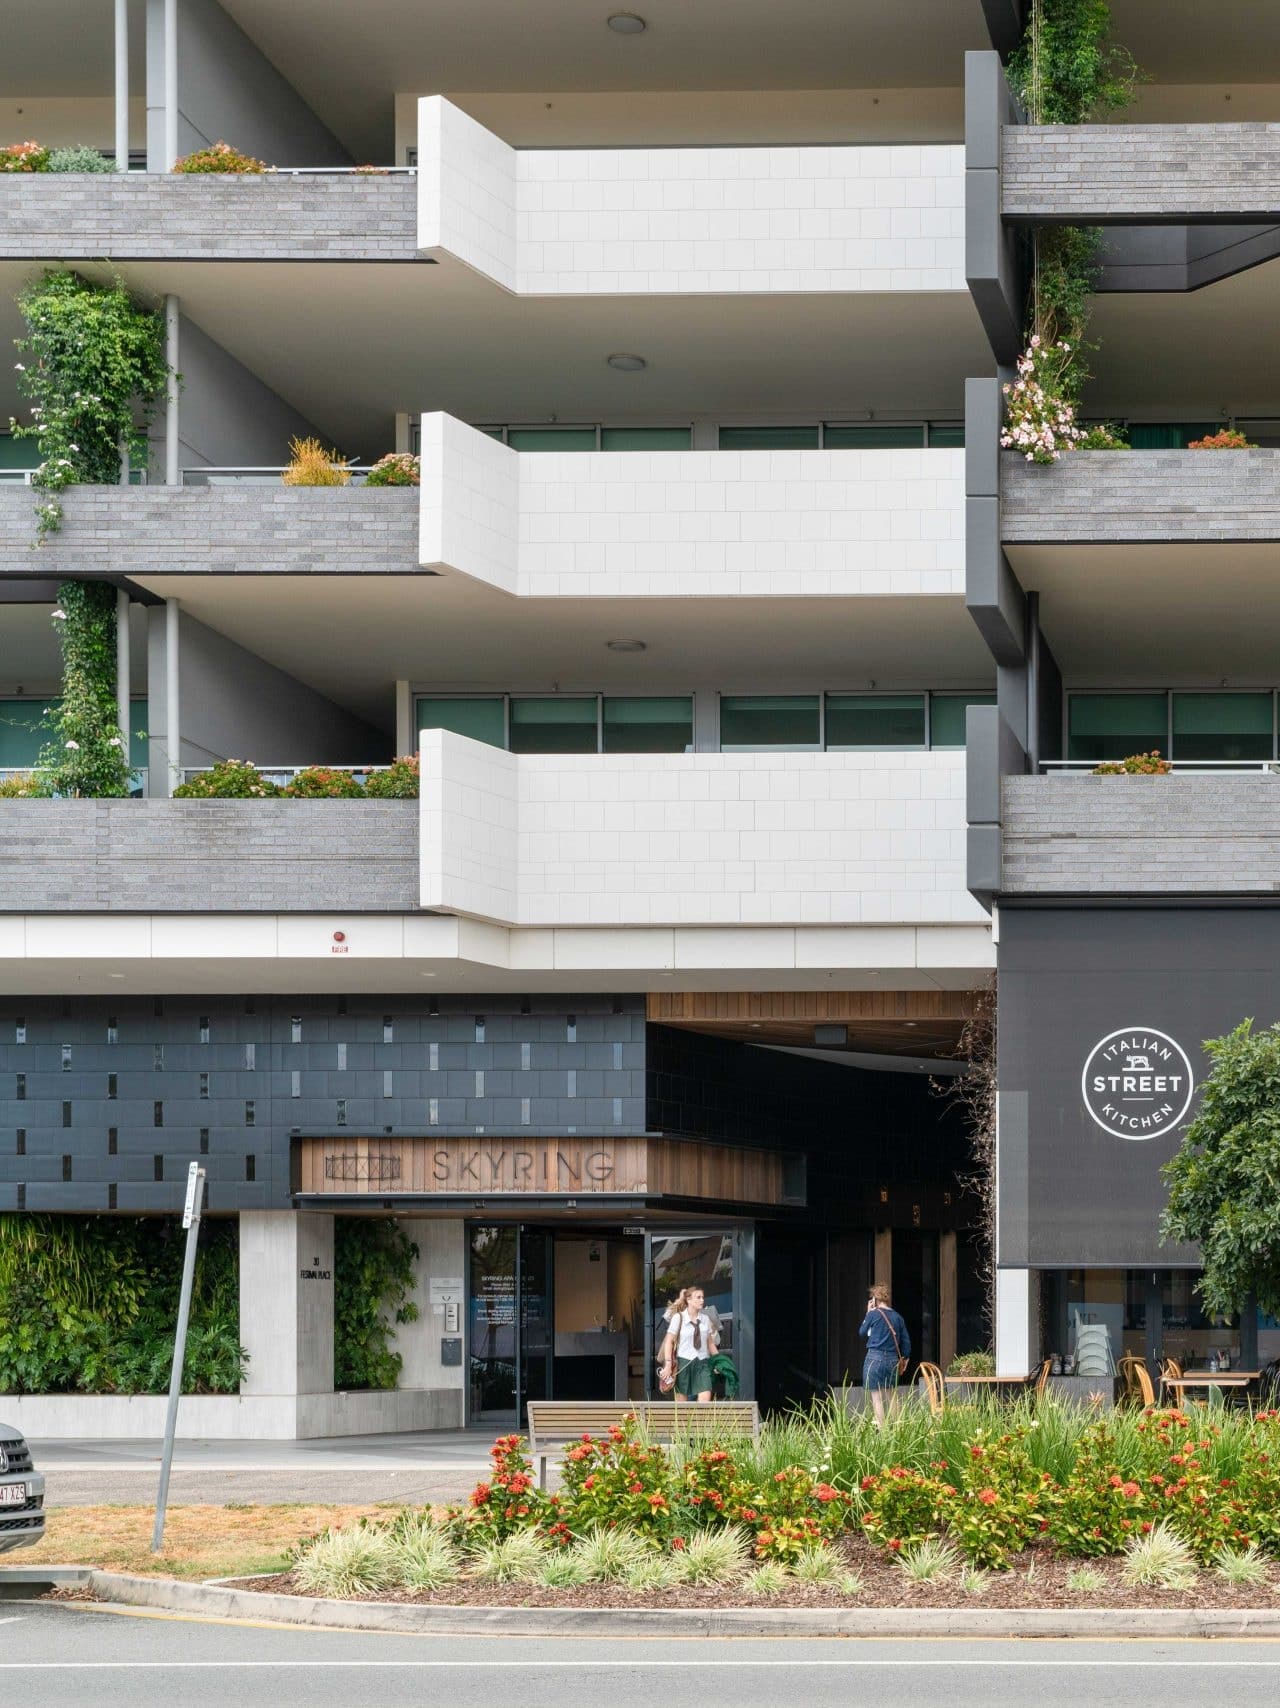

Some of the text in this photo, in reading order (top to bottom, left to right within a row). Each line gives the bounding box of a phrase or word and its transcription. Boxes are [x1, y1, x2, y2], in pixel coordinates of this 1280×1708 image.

[1103, 1038, 1172, 1061] ITALIAN
[1093, 1076, 1182, 1092] STREET
[1102, 1103, 1173, 1128] KITCHEN
[433, 1151, 613, 1181] SKYRING
